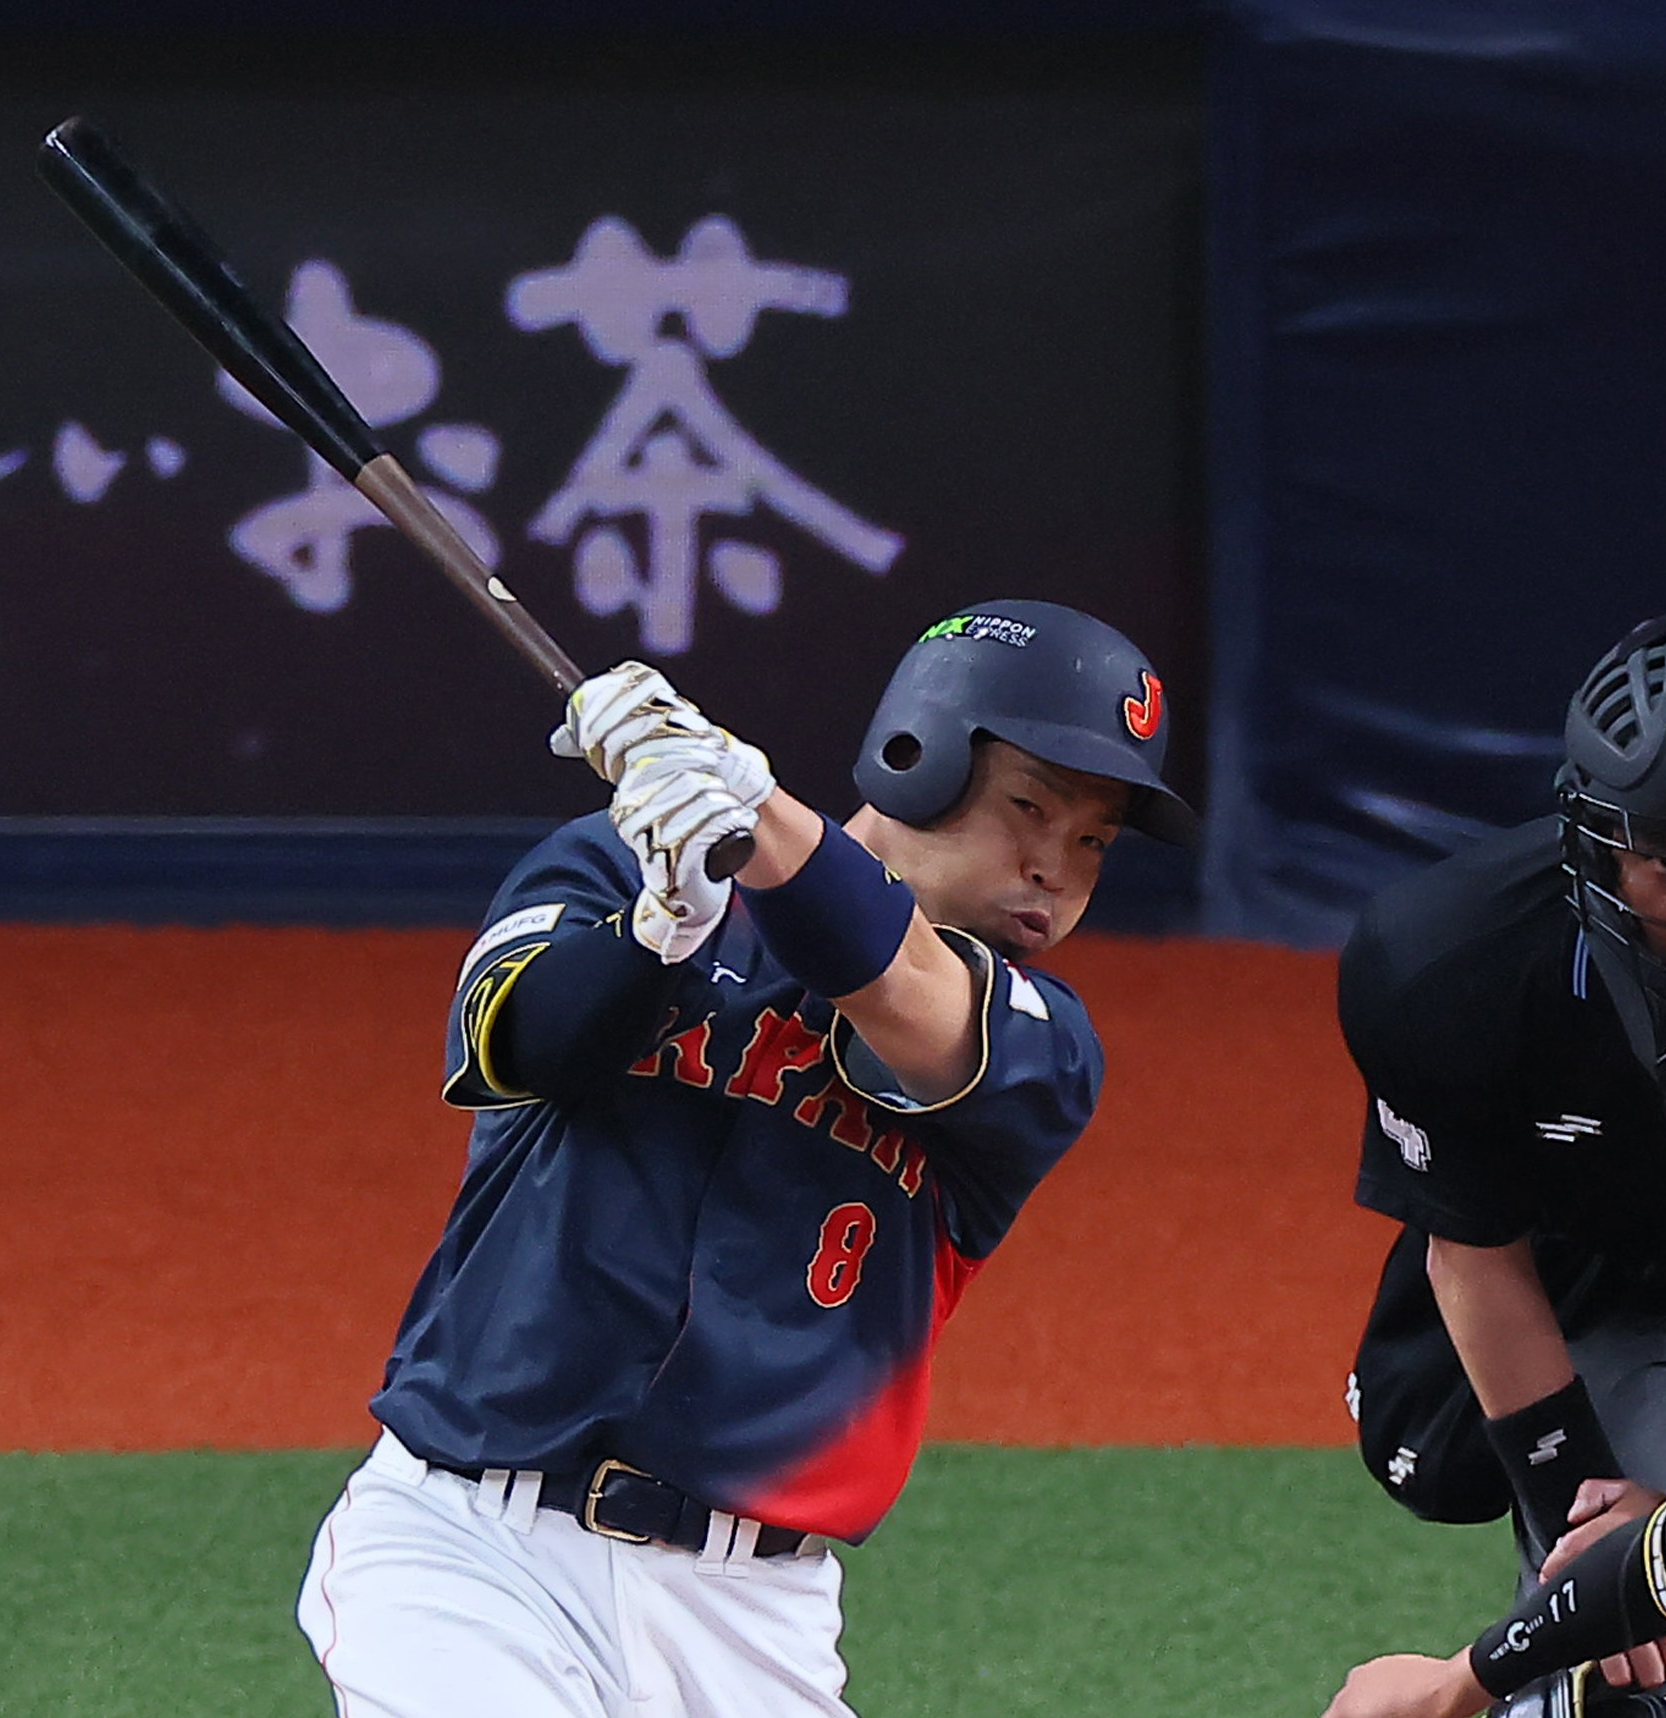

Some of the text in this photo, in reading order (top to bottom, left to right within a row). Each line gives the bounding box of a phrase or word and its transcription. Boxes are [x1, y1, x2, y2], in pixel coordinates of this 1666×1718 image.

[971, 616, 1036, 639] NIPPON
[1123, 671, 1163, 740] J
[807, 1202, 877, 1309] 8
[1548, 1579, 1576, 1623] 17
